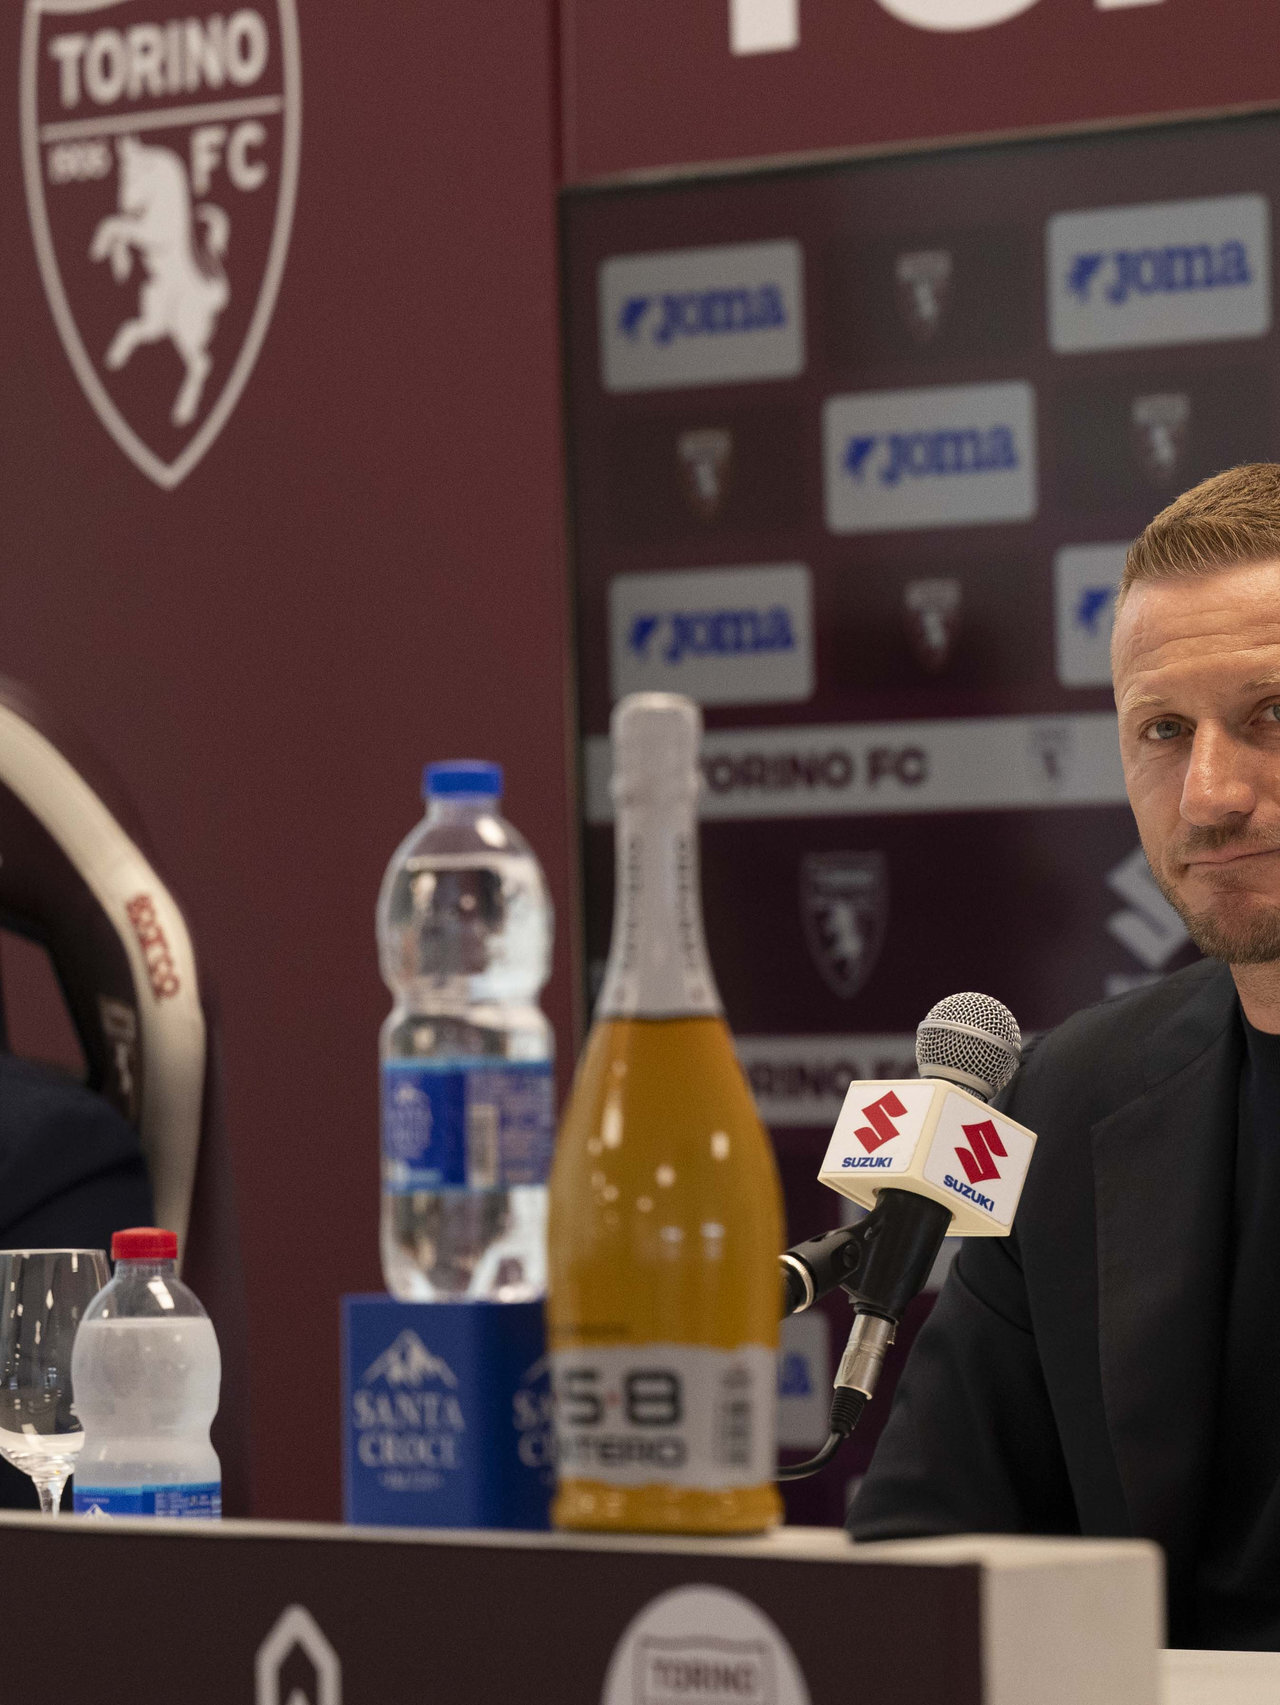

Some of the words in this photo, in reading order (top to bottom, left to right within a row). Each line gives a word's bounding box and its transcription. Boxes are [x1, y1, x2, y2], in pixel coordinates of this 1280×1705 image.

[50, 8, 269, 109] TORINO
[190, 120, 268, 197] FC
[700, 750, 855, 794] ORINO
[864, 744, 929, 789] FC
[841, 1156, 893, 1168] SUZUKI
[943, 1174, 995, 1212] SUZUKI
